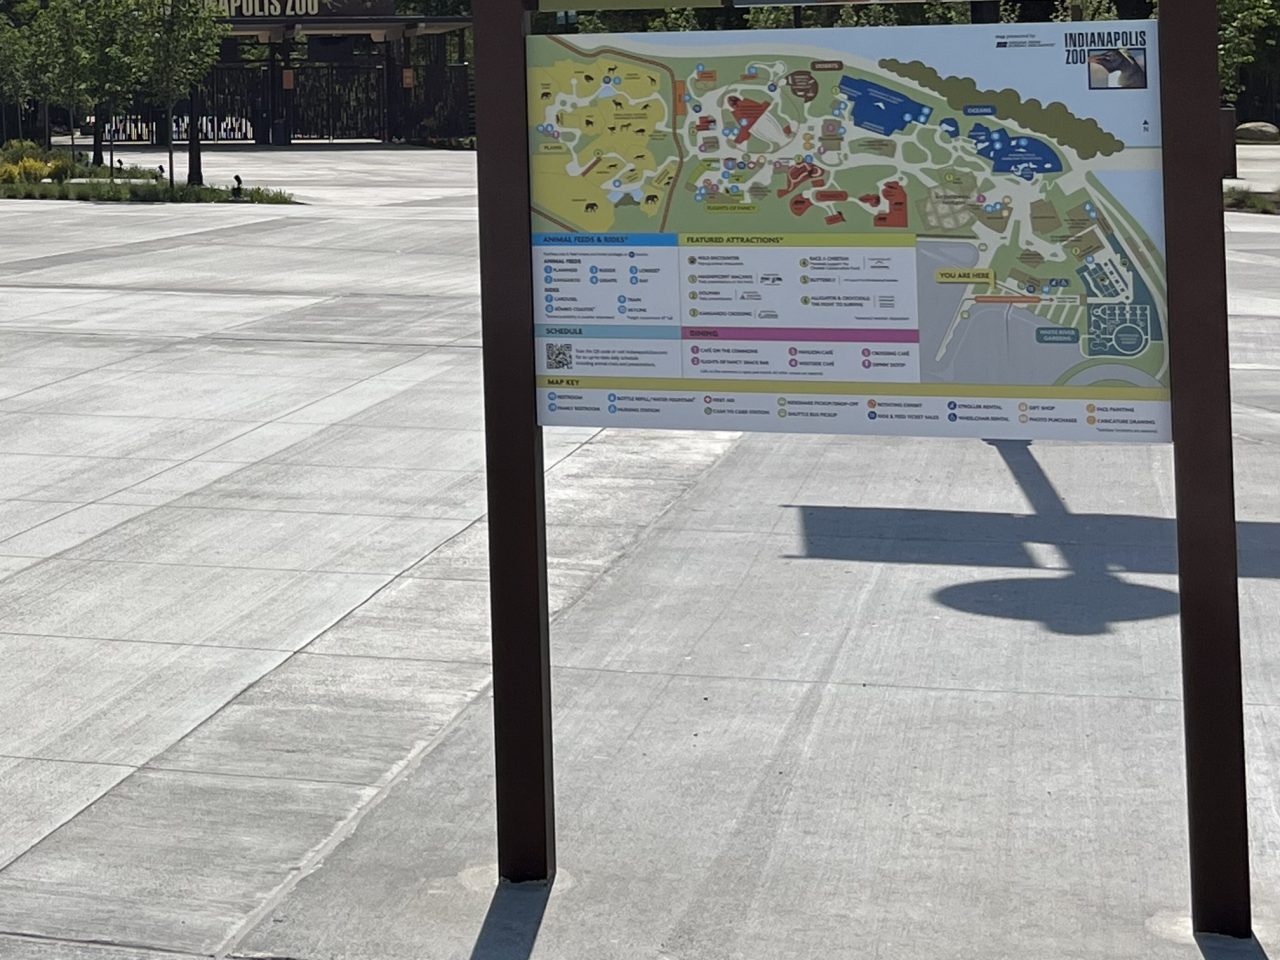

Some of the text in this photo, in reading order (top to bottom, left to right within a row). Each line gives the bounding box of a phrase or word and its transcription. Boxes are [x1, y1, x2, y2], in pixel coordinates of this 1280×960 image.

[1064, 30, 1147, 48] INDIANAPOLIS
[1066, 49, 1086, 64] ZOO
[686, 236, 724, 244] FEATURED
